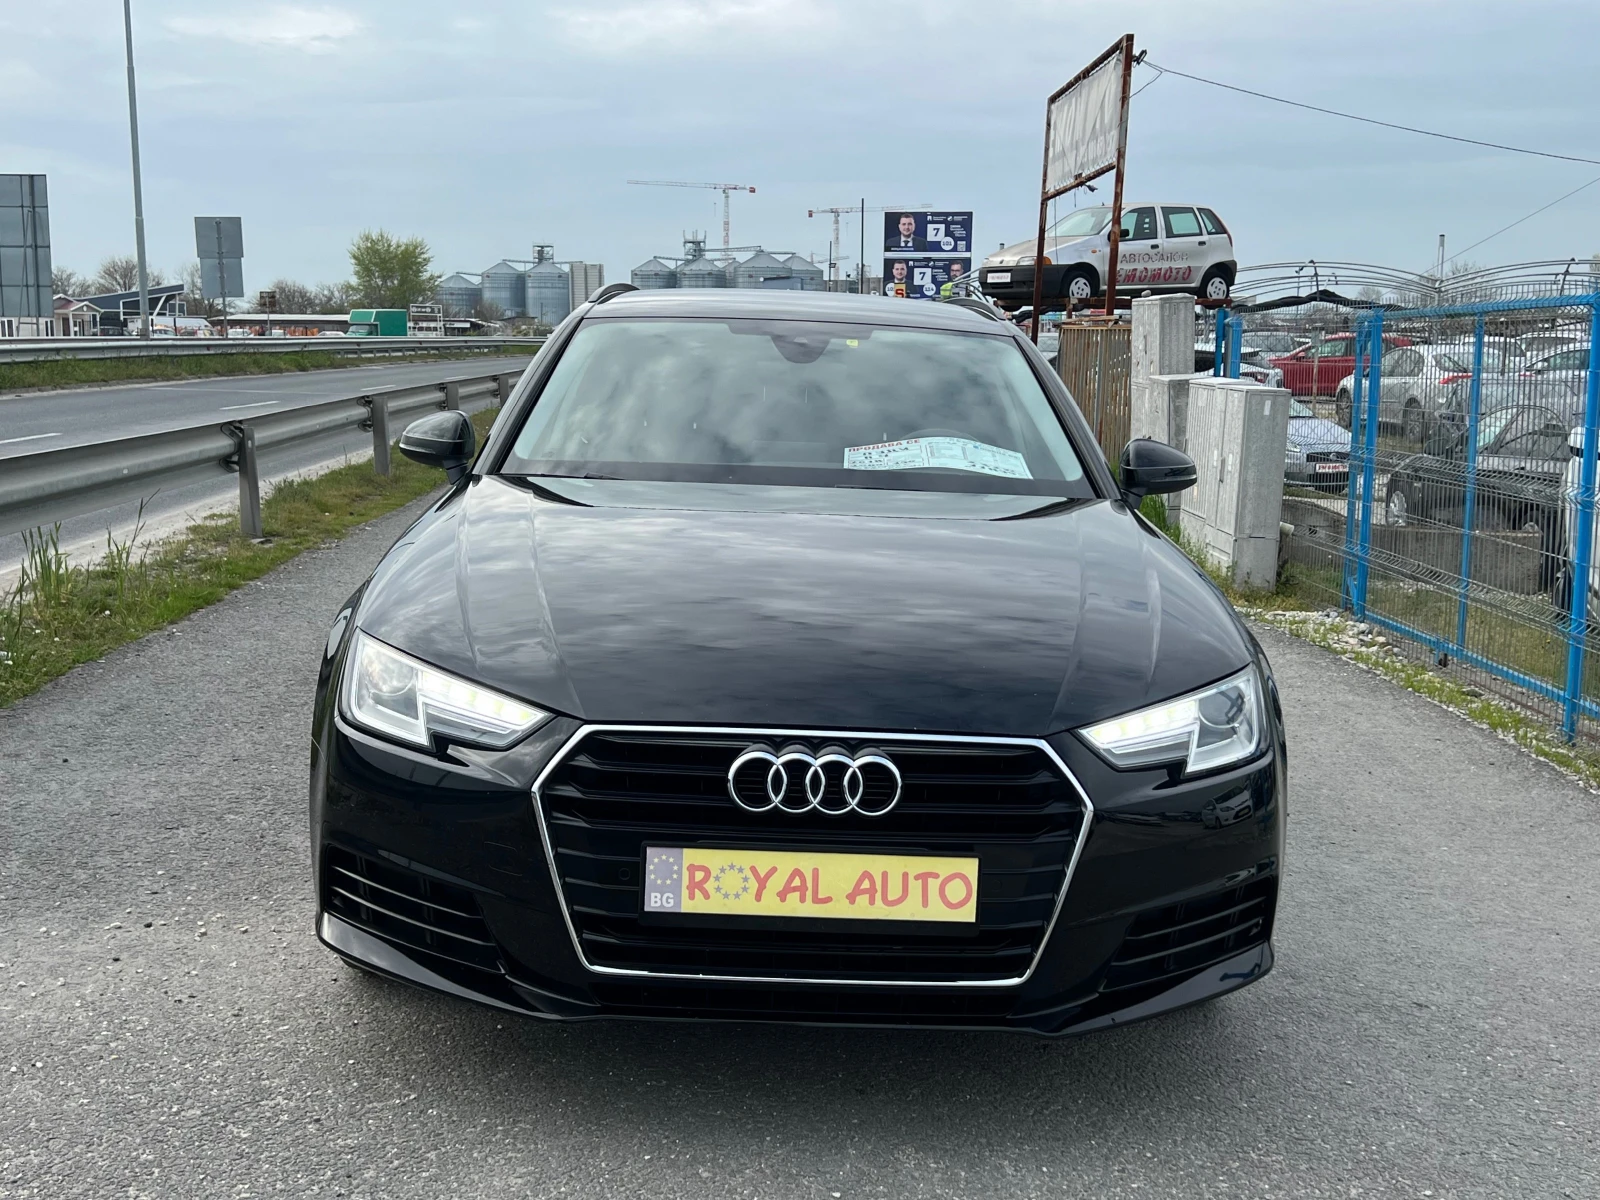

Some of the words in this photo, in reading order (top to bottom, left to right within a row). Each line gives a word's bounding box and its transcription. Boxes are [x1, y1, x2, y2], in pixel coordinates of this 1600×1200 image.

[651, 893, 674, 907] BG
[686, 863, 833, 905] ROYAL
[846, 869, 973, 910] AUTO
